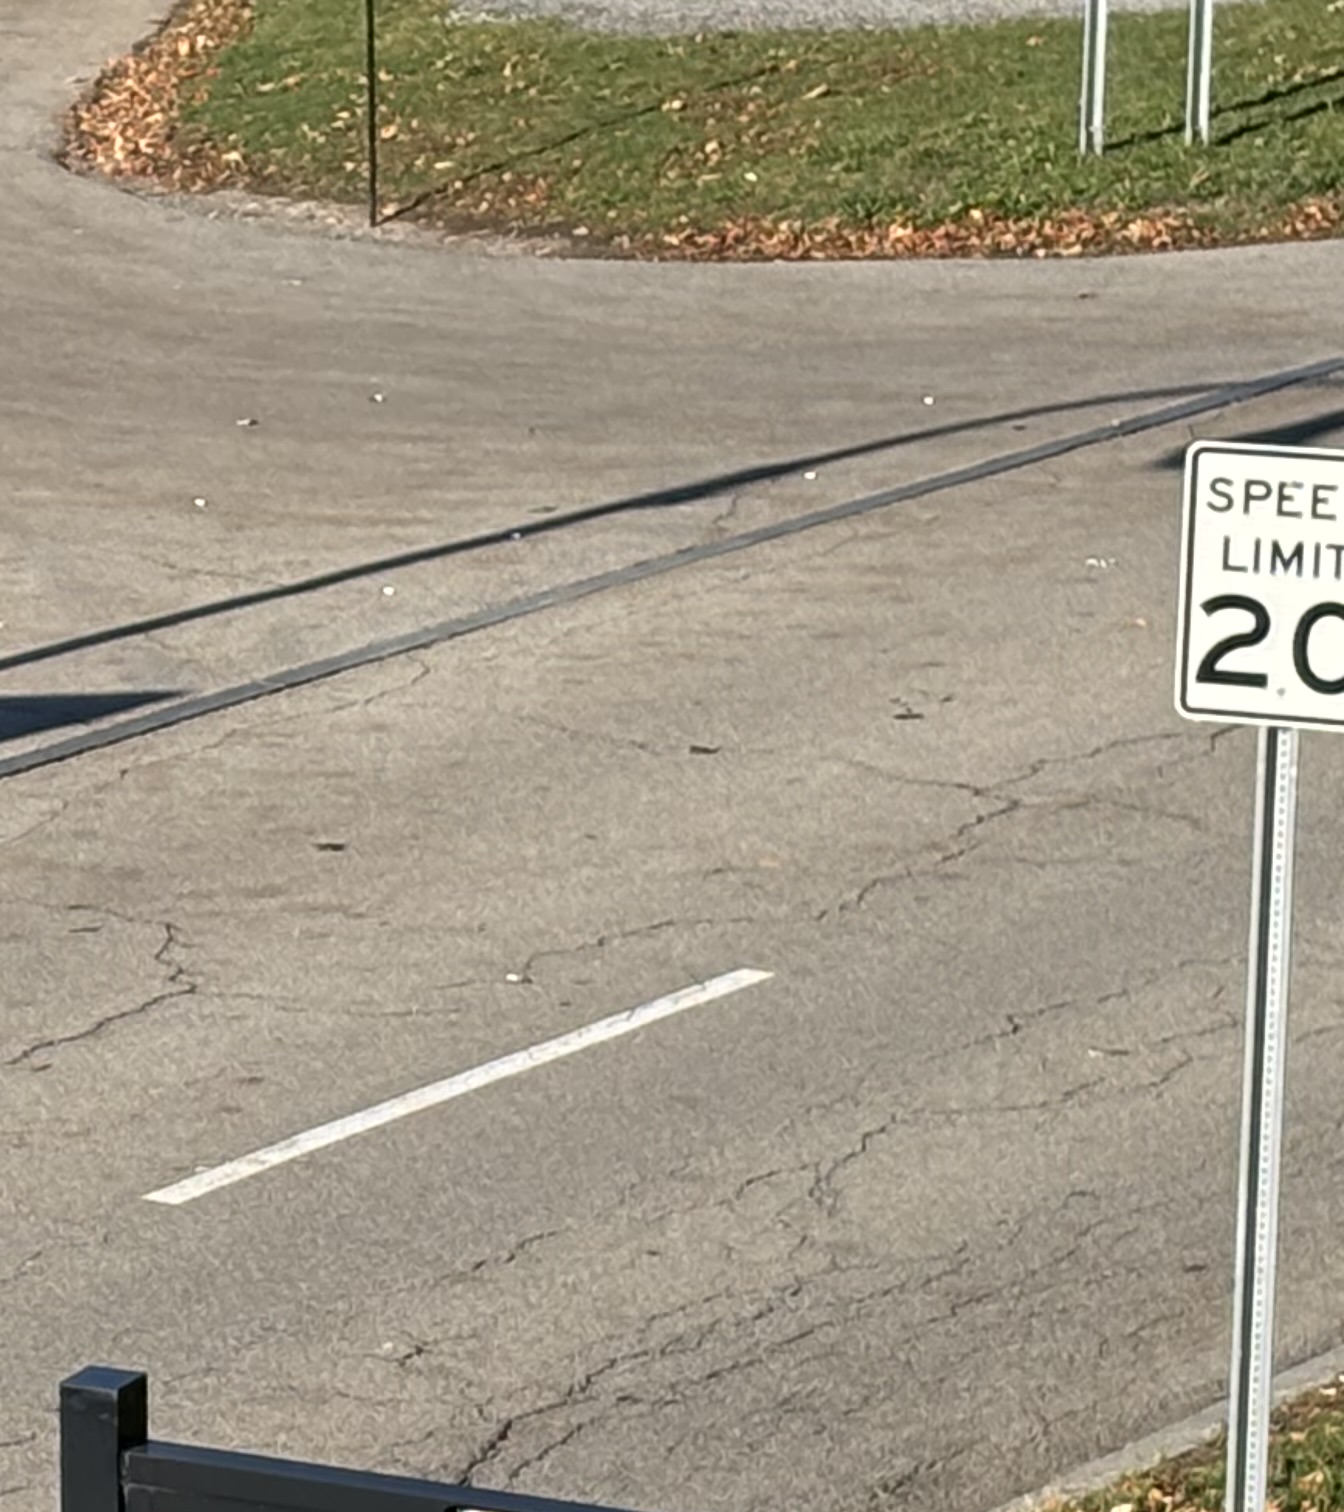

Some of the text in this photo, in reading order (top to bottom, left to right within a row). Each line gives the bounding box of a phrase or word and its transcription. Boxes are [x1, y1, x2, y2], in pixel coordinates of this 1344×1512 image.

[1206, 476, 1339, 521] SPEE
[1221, 535, 1344, 580] LIMIT
[1195, 593, 1344, 695] 20
